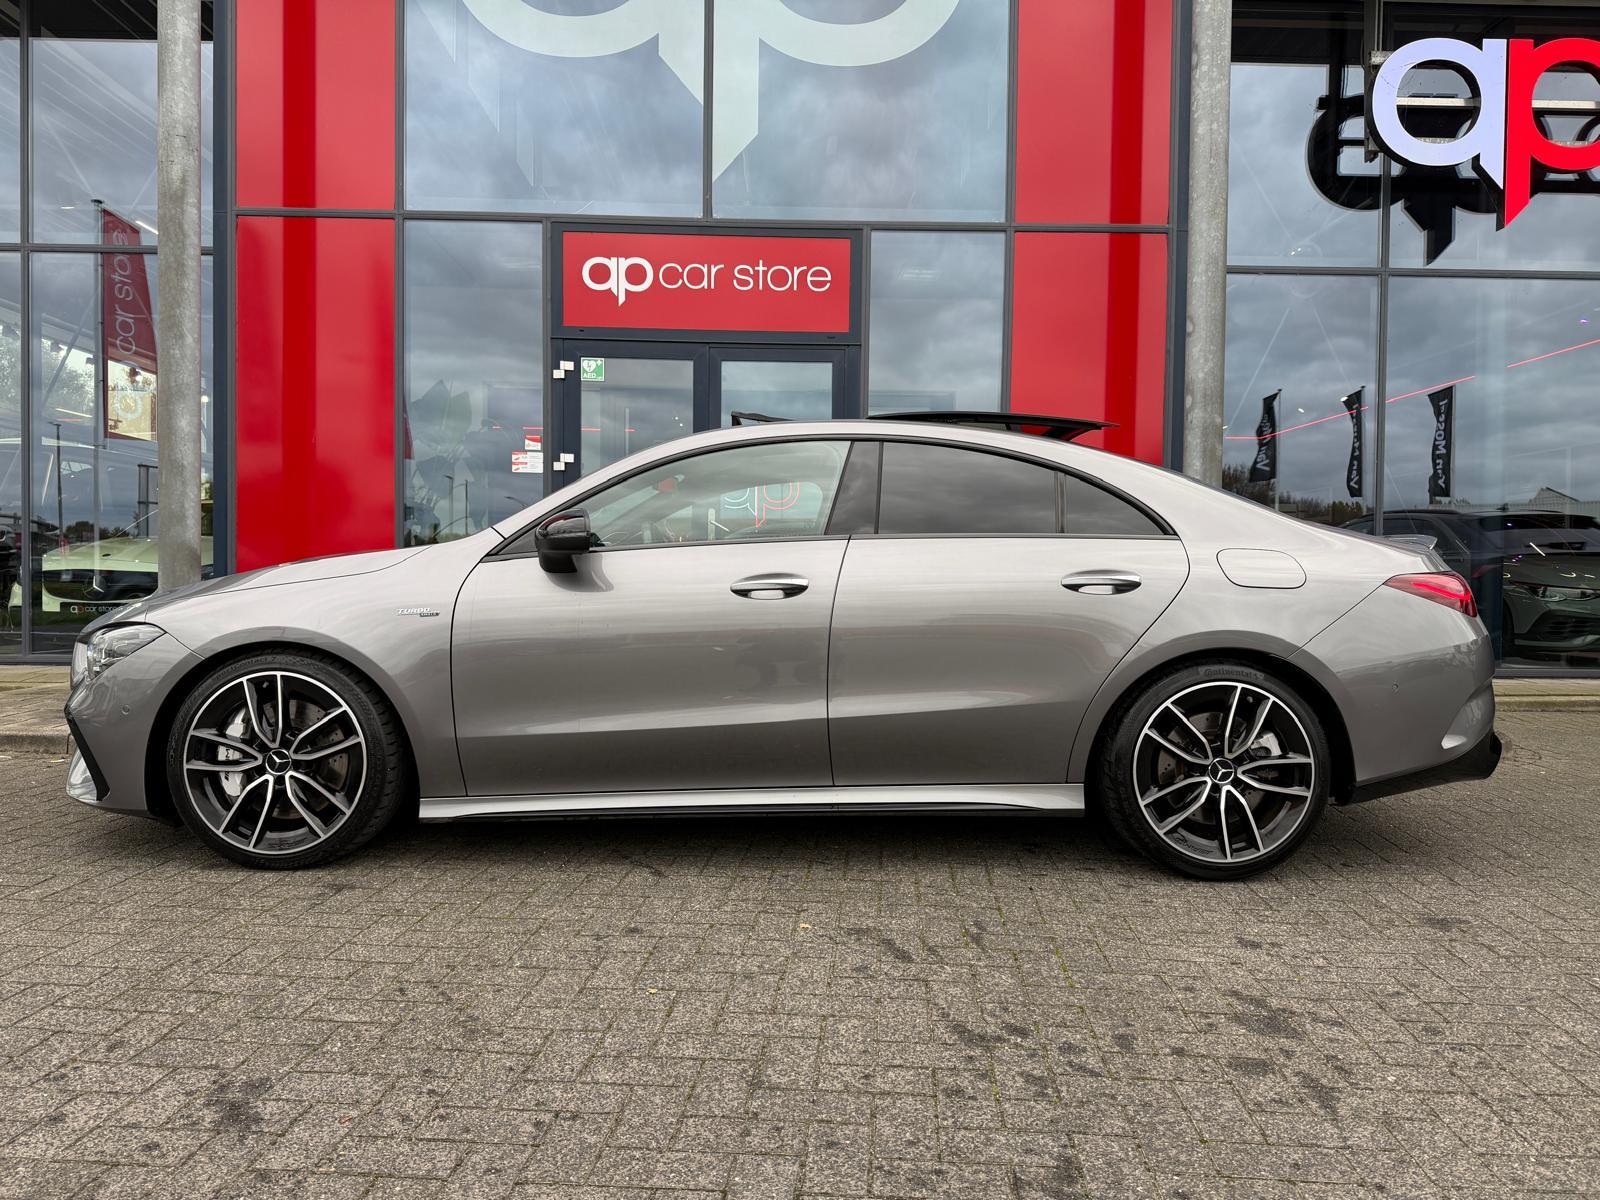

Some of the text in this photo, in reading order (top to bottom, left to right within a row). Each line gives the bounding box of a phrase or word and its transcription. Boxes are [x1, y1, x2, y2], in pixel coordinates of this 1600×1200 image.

[111, 229, 134, 301] stoe
[582, 256, 833, 307] ap car store
[115, 308, 136, 355] car
